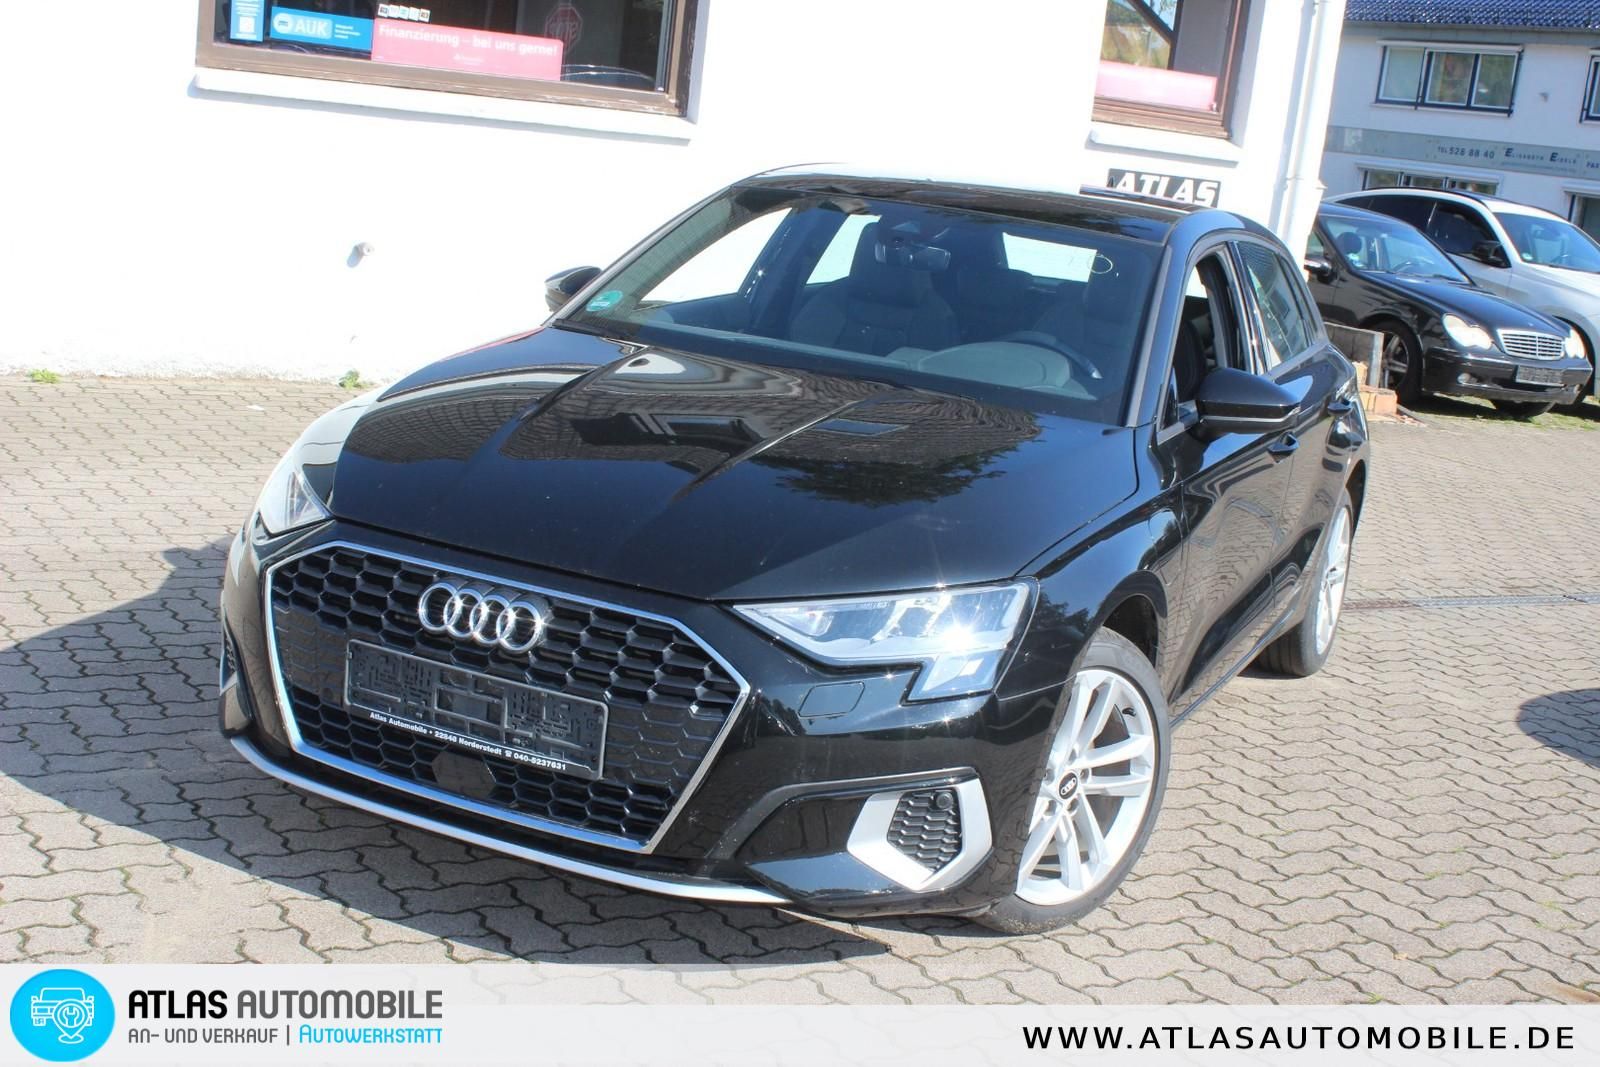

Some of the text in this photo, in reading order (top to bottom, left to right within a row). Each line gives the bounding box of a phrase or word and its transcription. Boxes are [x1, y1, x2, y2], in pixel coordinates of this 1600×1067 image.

[295, 19, 329, 38] AUK
[379, 27, 459, 45] Finanzierung
[473, 37, 492, 48] bei
[496, 42, 516, 52] uns
[519, 44, 557, 56] gerne!
[1115, 172, 1220, 208] ATLAS
[370, 712, 387, 722] Atlas
[388, 718, 427, 734] Automobile
[458, 737, 502, 755] Norderstedt
